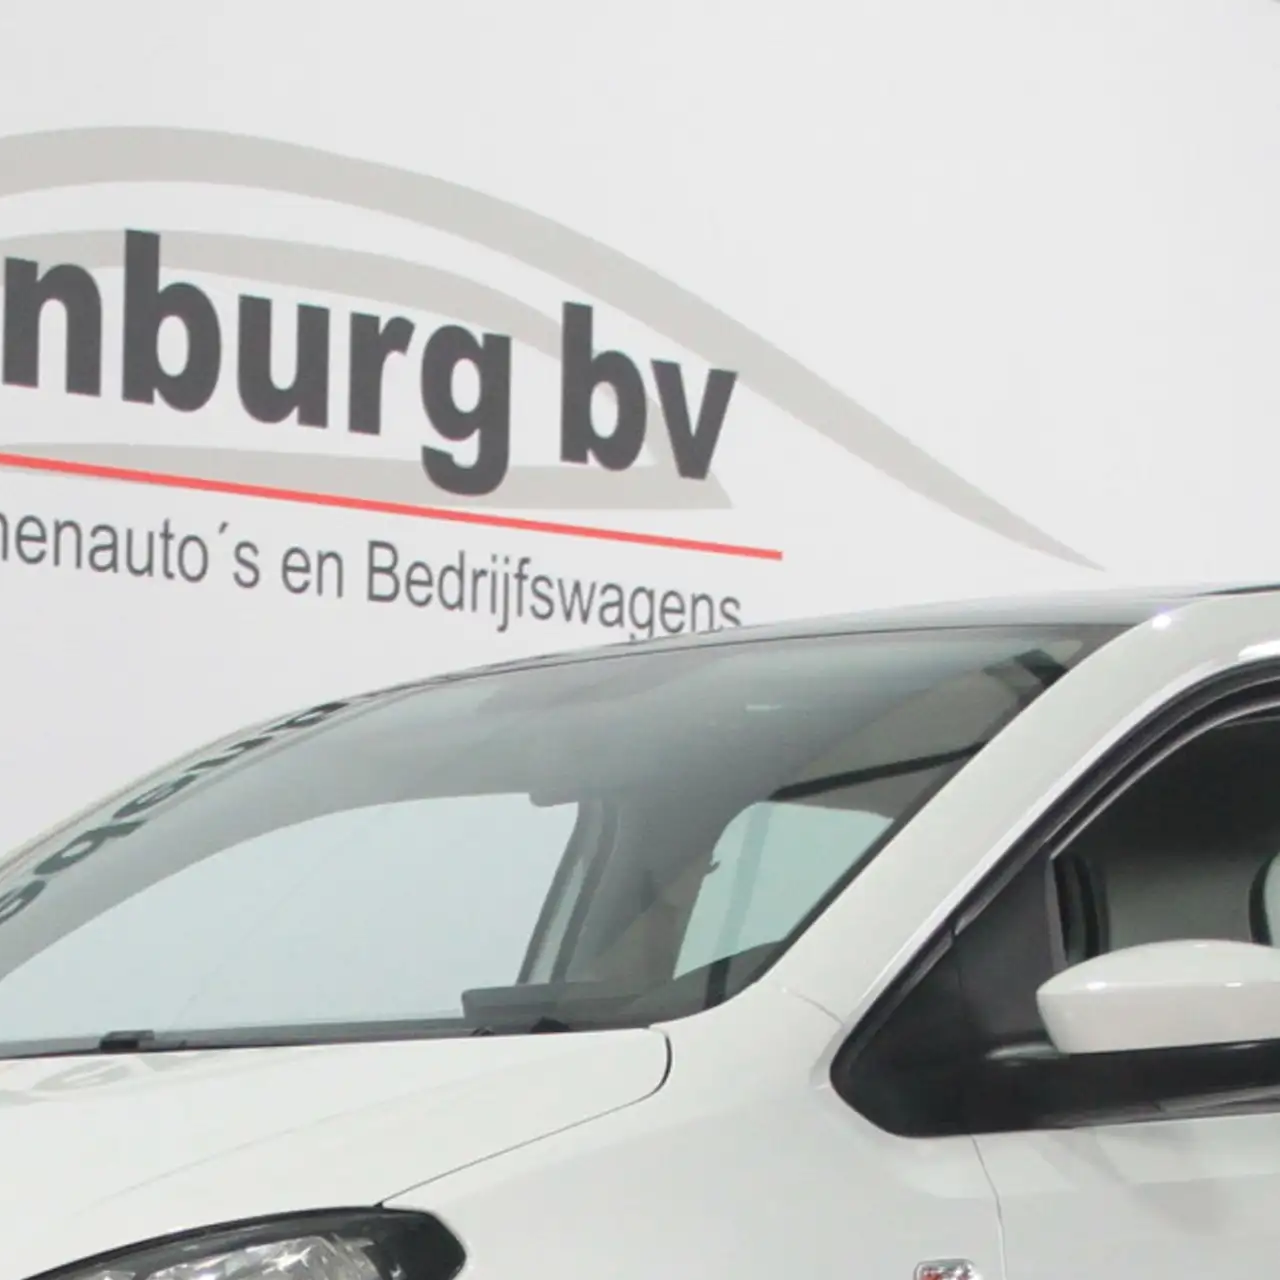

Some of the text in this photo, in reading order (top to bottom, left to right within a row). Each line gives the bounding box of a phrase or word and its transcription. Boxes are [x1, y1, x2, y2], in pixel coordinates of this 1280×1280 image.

[561, 302, 738, 480] bv
[281, 546, 344, 599] en
[366, 540, 743, 640] Bedrijfswagens
